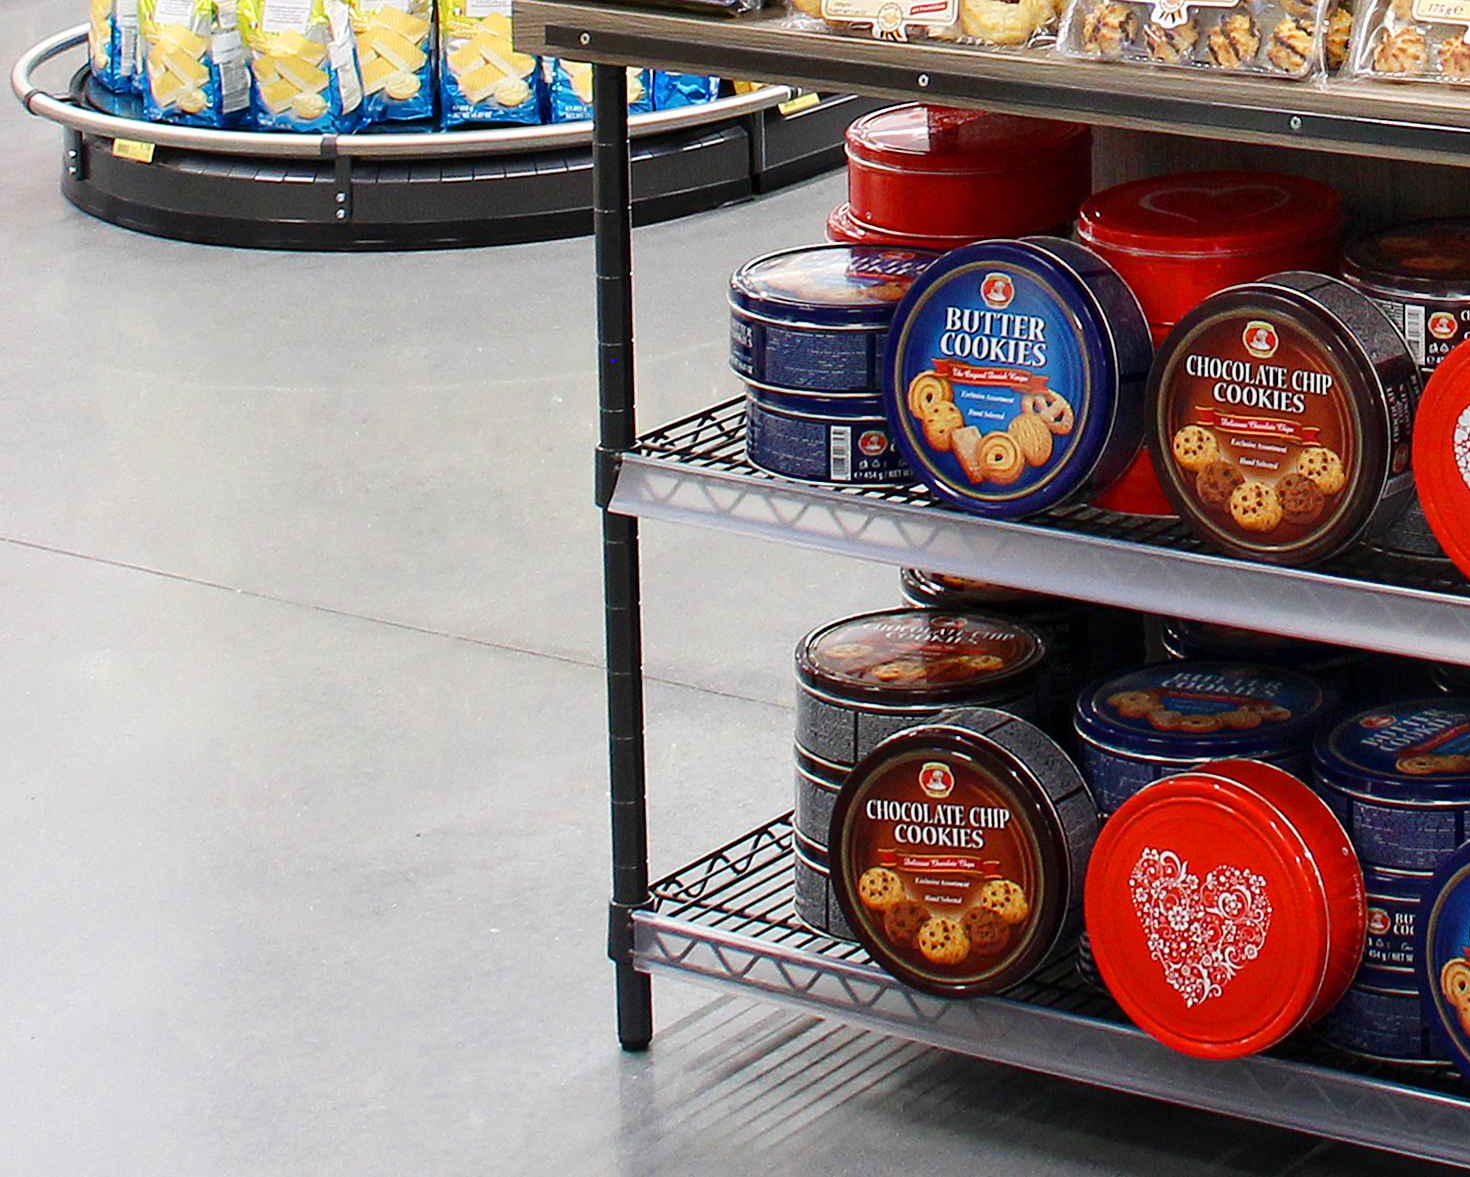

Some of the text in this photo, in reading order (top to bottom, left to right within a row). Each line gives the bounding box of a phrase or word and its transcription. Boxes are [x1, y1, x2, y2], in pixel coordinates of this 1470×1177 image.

[945, 306, 1047, 342] BUTTER
[940, 331, 1048, 367] COOKIES
[1186, 354, 1333, 396] CHOCOLATE CHIP
[1213, 382, 1305, 414] COOKIES
[866, 800, 1011, 829] CHOCOLATE CHIP
[894, 824, 985, 849] COOKIES
